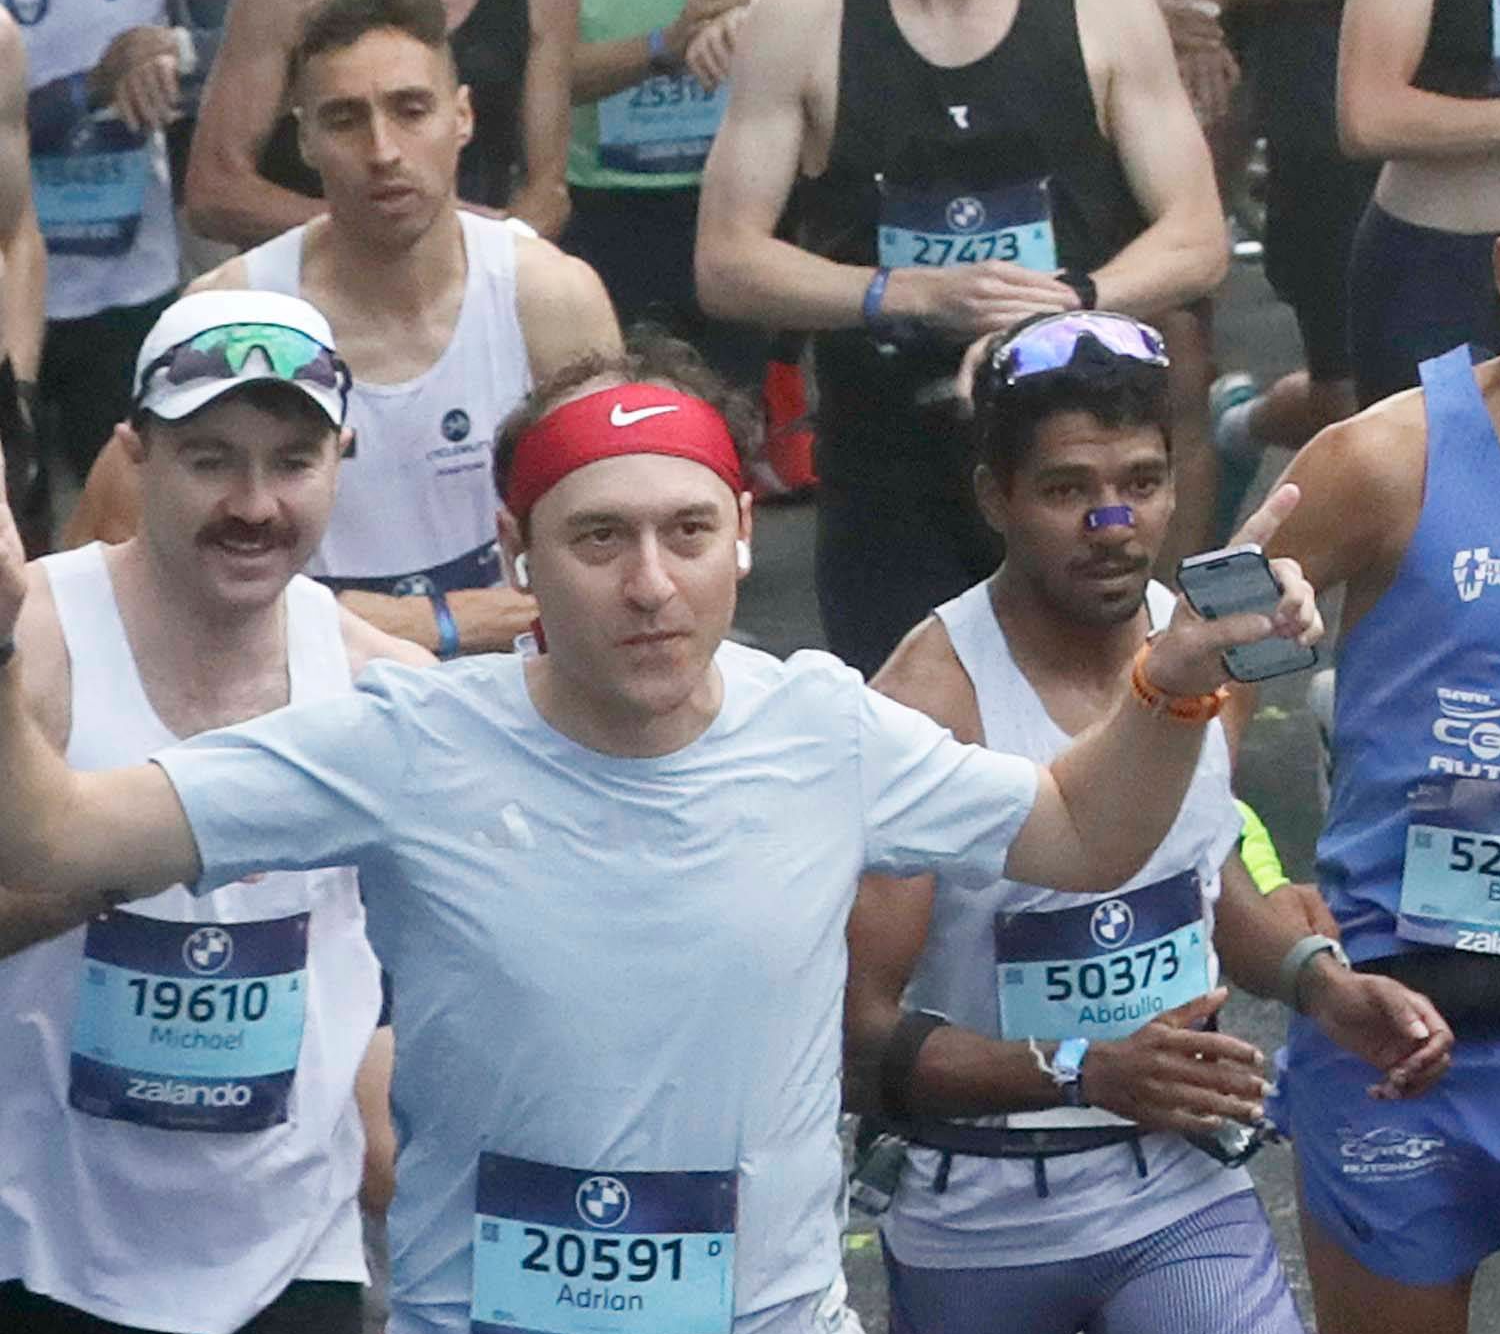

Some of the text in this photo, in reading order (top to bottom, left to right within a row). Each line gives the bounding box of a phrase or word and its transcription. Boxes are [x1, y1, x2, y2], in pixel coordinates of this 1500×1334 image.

[908, 232, 1018, 267] 27473
[1045, 939, 1180, 1003] 50373
[126, 978, 270, 1024] 19610
[149, 1025, 245, 1052] Michael
[126, 1077, 252, 1109] zalando
[520, 1226, 686, 1284] 20591
[555, 1283, 644, 1312] Adrian
